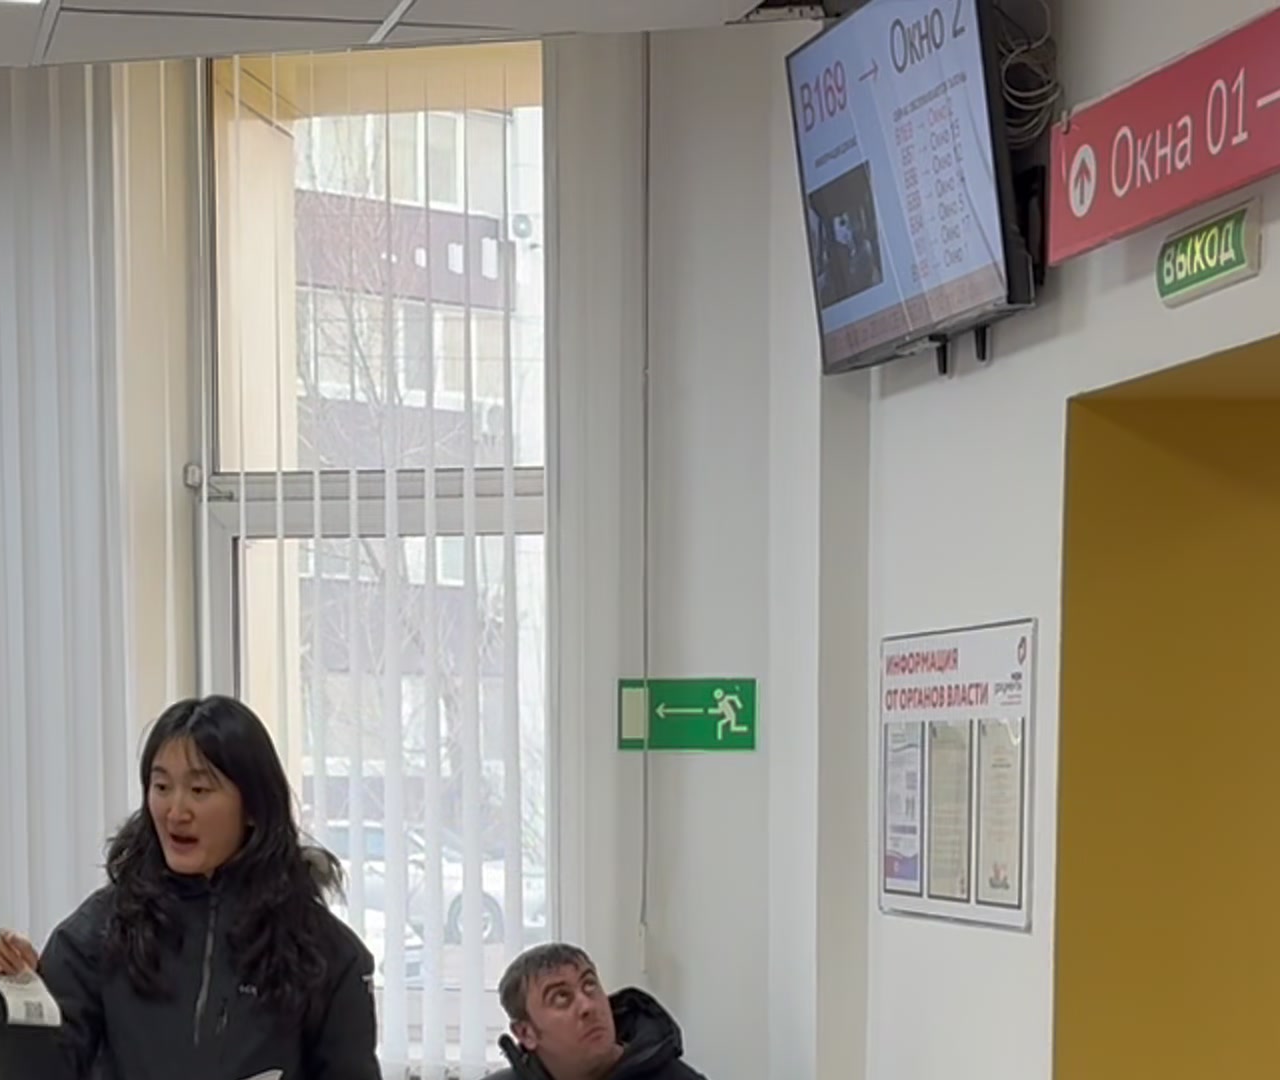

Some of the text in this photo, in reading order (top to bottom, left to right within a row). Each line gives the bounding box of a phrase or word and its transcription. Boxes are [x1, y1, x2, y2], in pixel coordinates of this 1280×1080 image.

[889, 8, 944, 74] Окно
[1111, 114, 1193, 198] Окна
[1163, 219, 1236, 286] ВЫХОД
[886, 648, 958, 675] ИНФОРМАЦИЯ
[886, 689, 898, 710] ОТ
[901, 686, 944, 709] ОРГАНОВ
[947, 682, 988, 706] ВЛАСТИ
